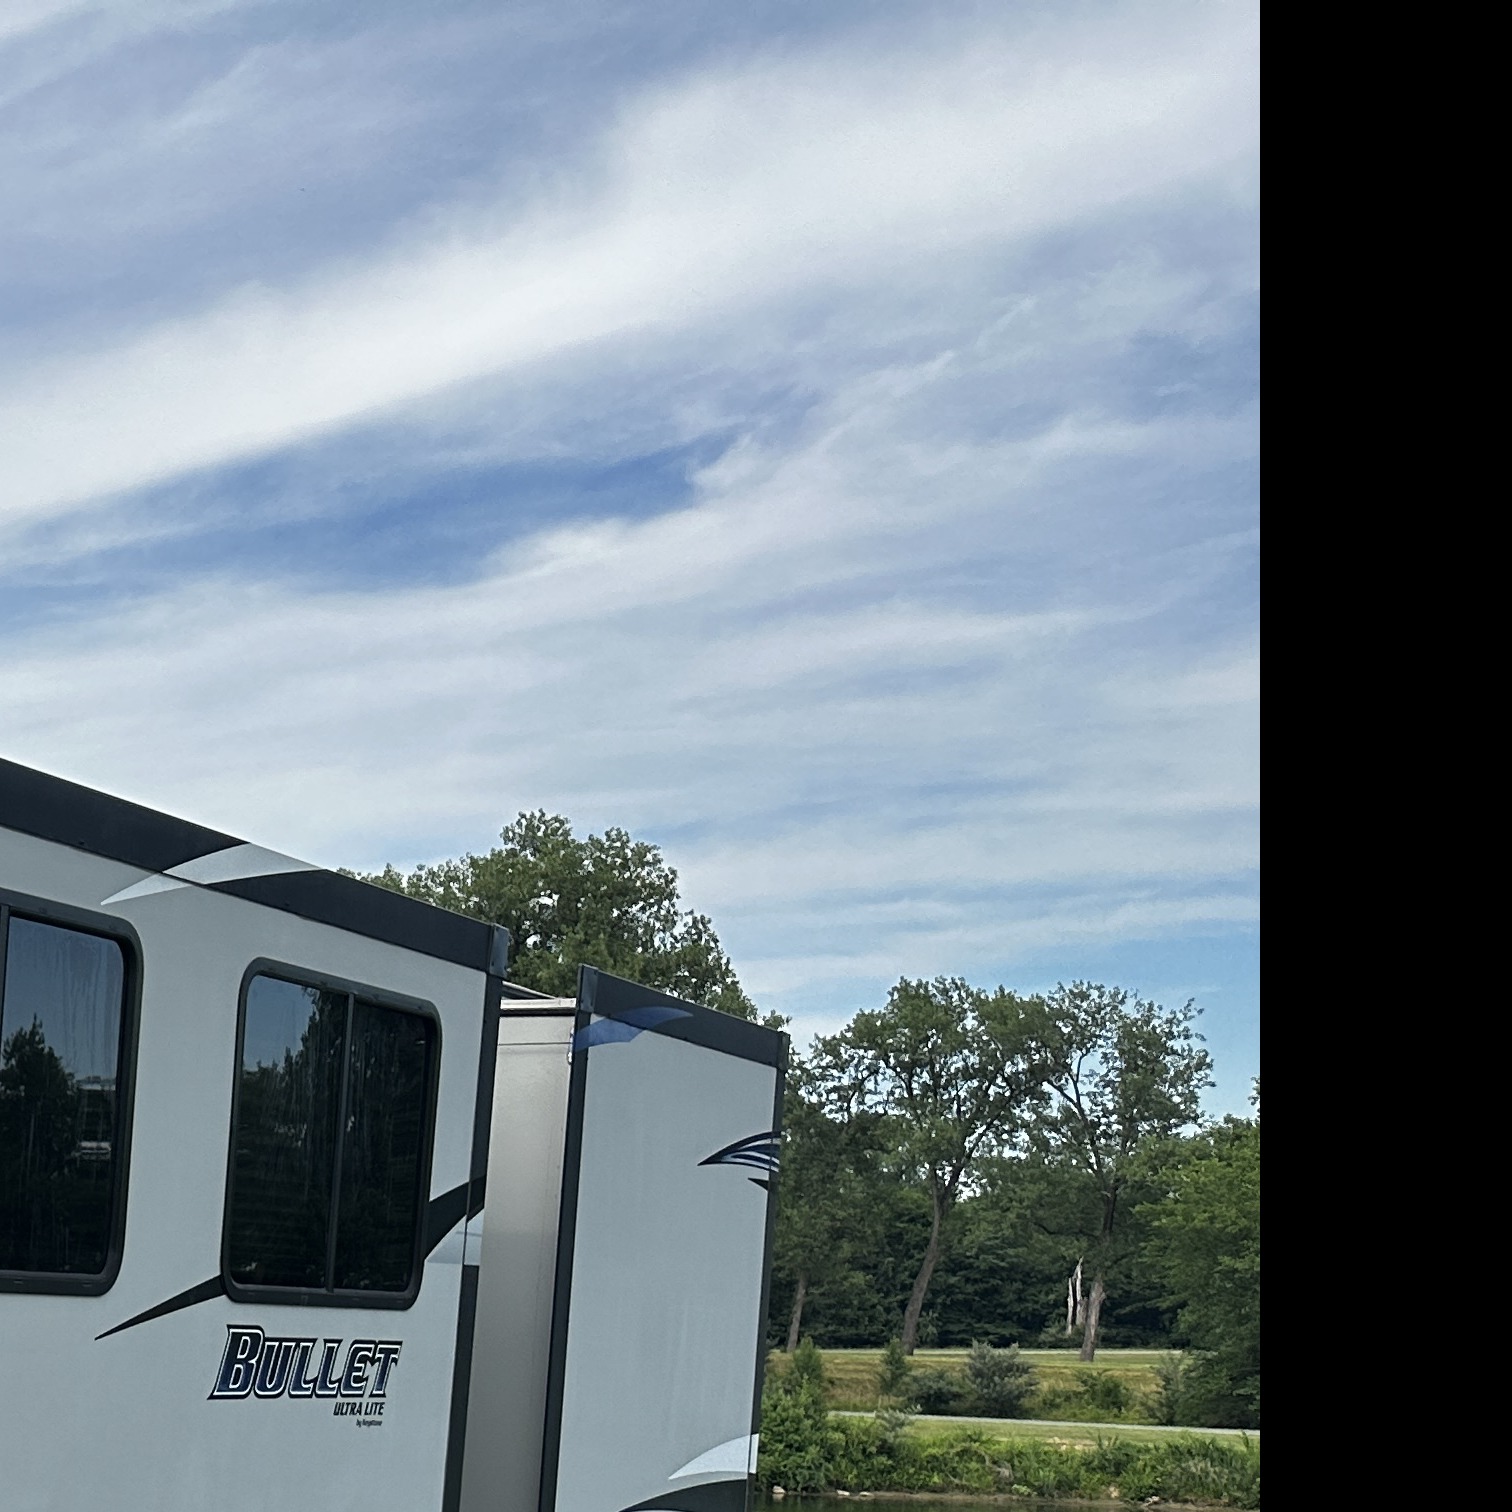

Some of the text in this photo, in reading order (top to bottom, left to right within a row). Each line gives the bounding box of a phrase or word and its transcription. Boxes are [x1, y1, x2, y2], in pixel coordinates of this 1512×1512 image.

[207, 1324, 403, 1400] BULLET
[333, 1402, 385, 1416] ULTRA LITE
